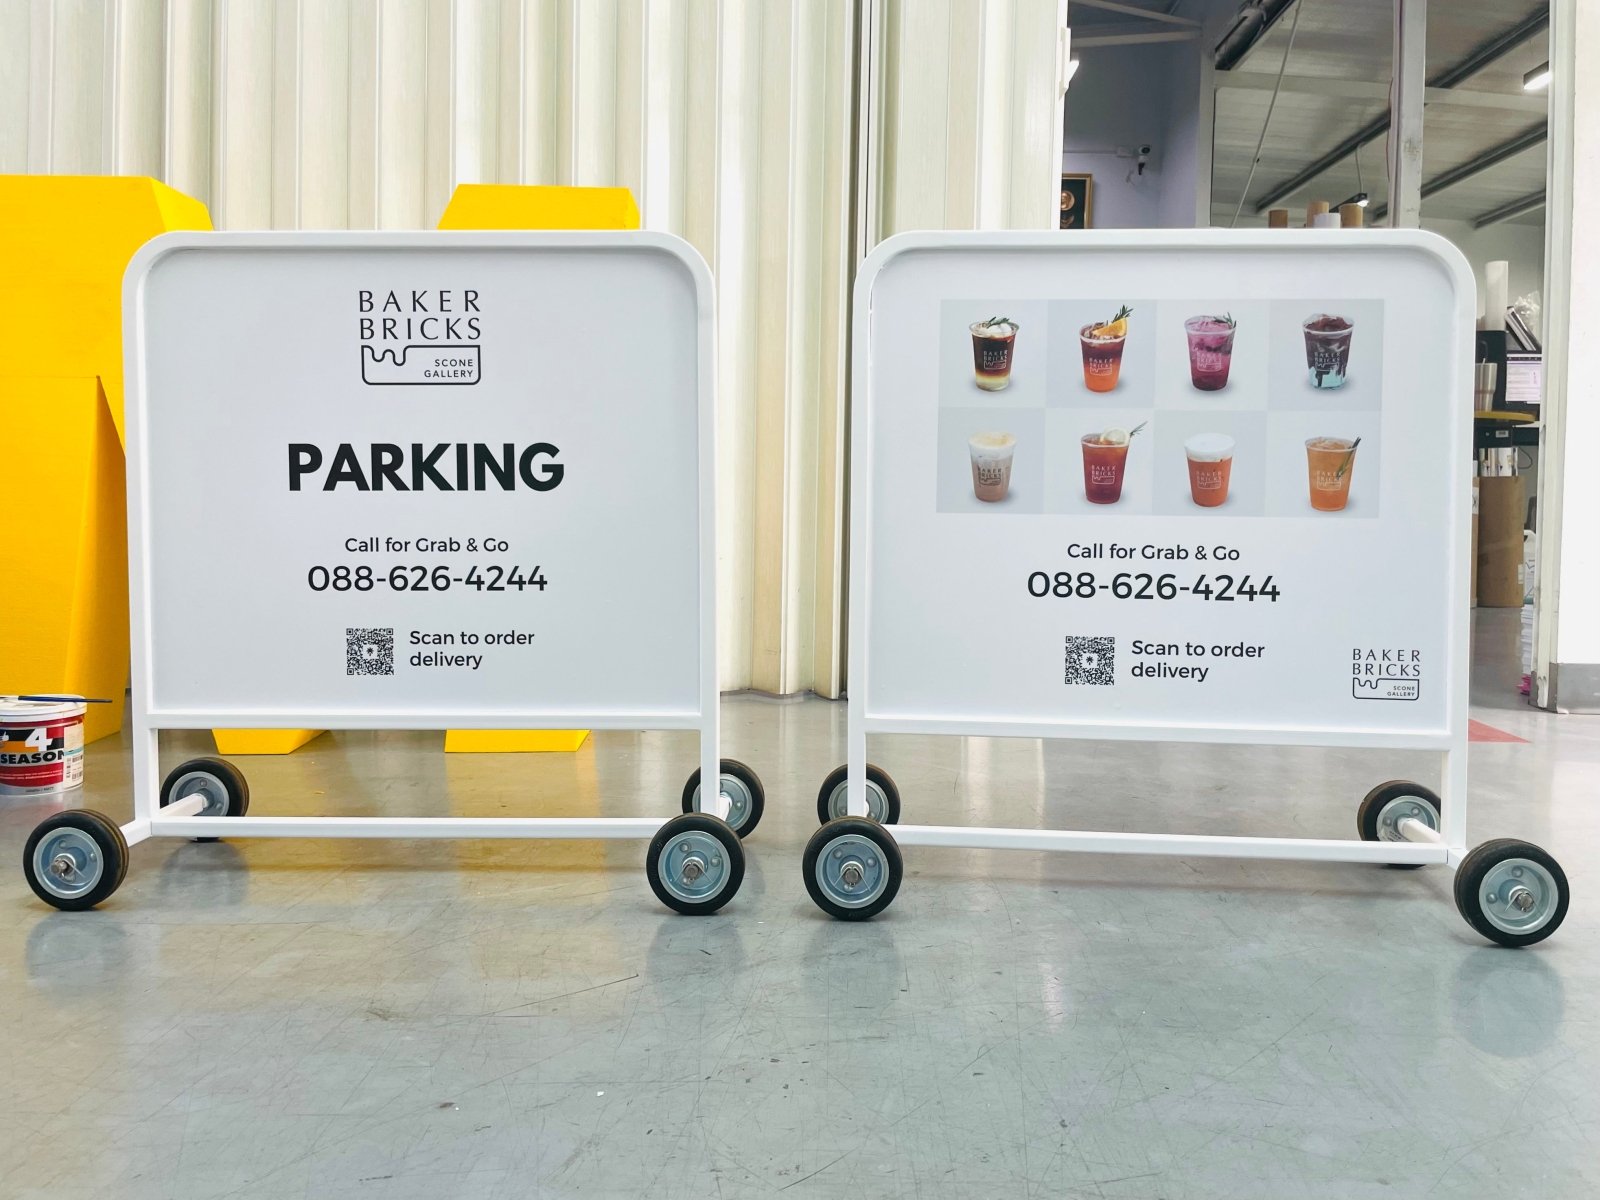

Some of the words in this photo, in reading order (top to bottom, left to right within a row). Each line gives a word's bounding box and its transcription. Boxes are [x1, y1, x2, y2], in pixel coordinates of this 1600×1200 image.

[359, 289, 481, 313] BAKER
[360, 317, 481, 341] BRICKS
[434, 358, 474, 368] SCONE
[423, 369, 474, 379] GALLERY
[288, 442, 565, 492] PARKING
[345, 536, 380, 553] Call
[384, 536, 412, 553] for
[415, 536, 461, 553] Grab
[466, 537, 479, 553] &
[483, 537, 509, 553] Go
[1067, 542, 1103, 560] Call
[1109, 543, 1137, 560] for
[1141, 544, 1189, 561] Grab
[1194, 545, 1208, 561] &
[1212, 545, 1240, 561] Go
[307, 565, 548, 592] 088-626-4244
[1027, 571, 1281, 603] 088-626-4244
[409, 630, 455, 645] Scan
[459, 631, 480, 645] to
[484, 629, 535, 645] order
[1131, 639, 1180, 656] Scan
[1184, 641, 1206, 657] to
[1210, 641, 1266, 658] order
[1352, 648, 1421, 663] BAKER
[409, 651, 483, 671] delivery
[1352, 662, 1421, 677] BRICKS
[1131, 661, 1209, 683] delivery
[25, 728, 53, 751] 4
